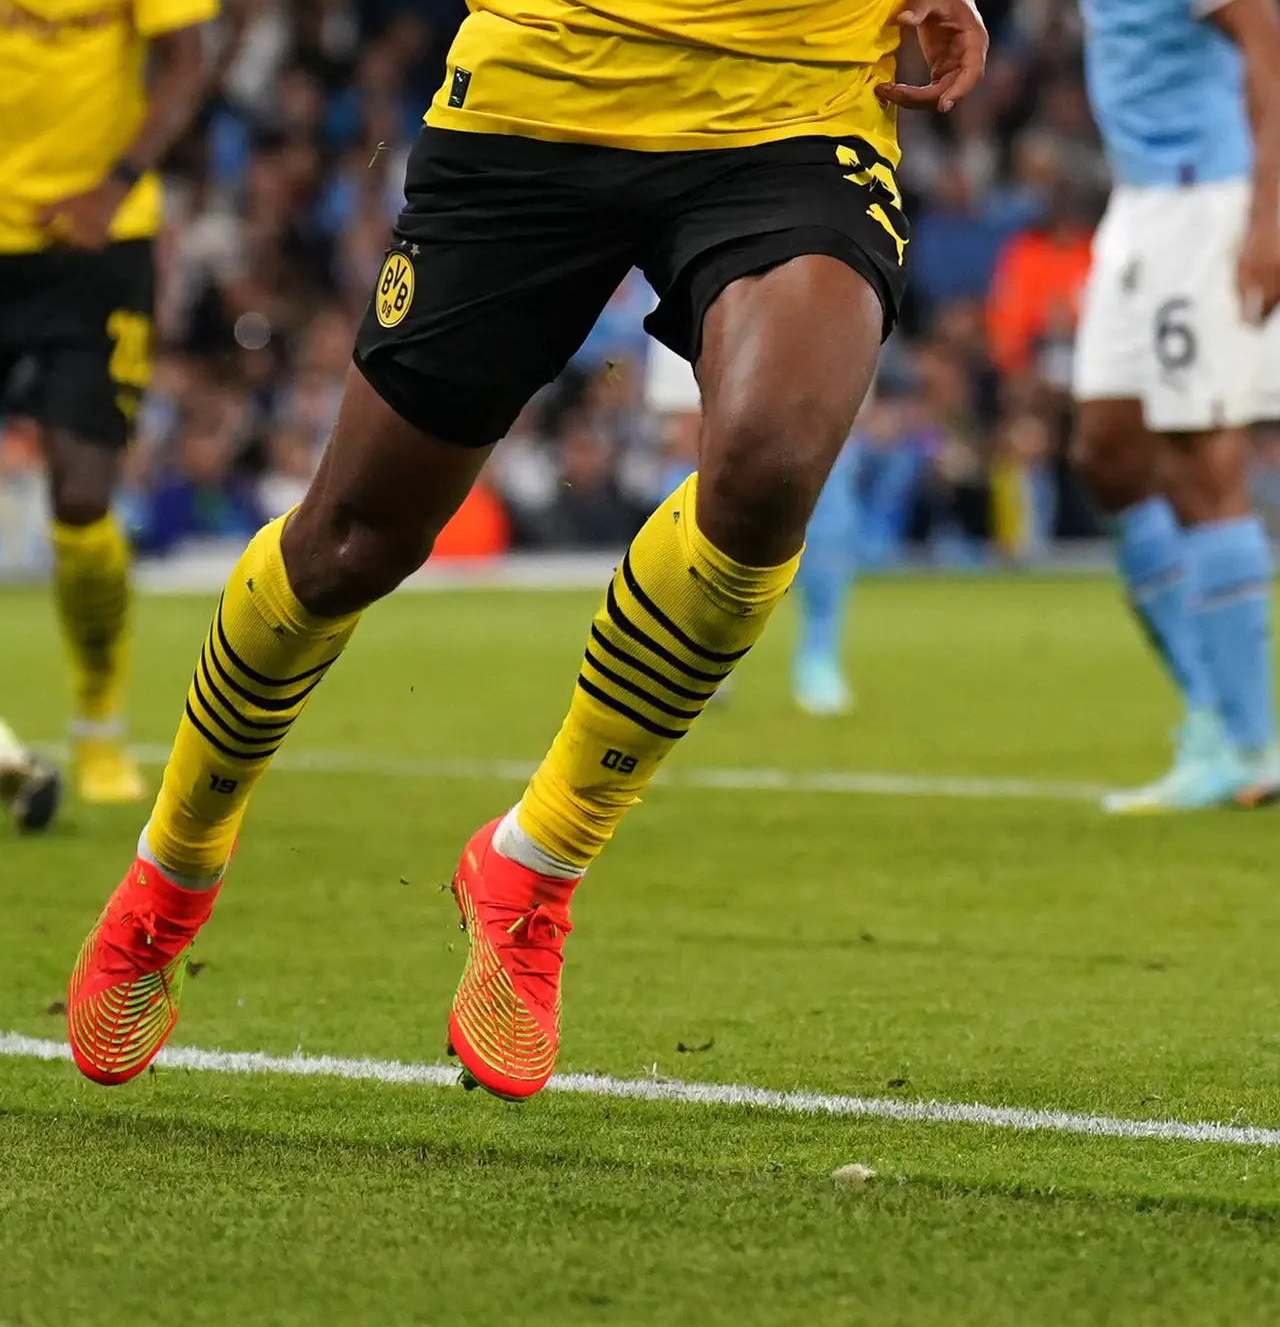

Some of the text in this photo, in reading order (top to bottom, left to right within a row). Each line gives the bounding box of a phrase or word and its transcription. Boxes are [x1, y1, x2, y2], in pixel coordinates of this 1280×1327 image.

[381, 258, 408, 312] BVB
[381, 300, 392, 318] 09
[1150, 293, 1198, 372] 6
[600, 748, 639, 774] 09
